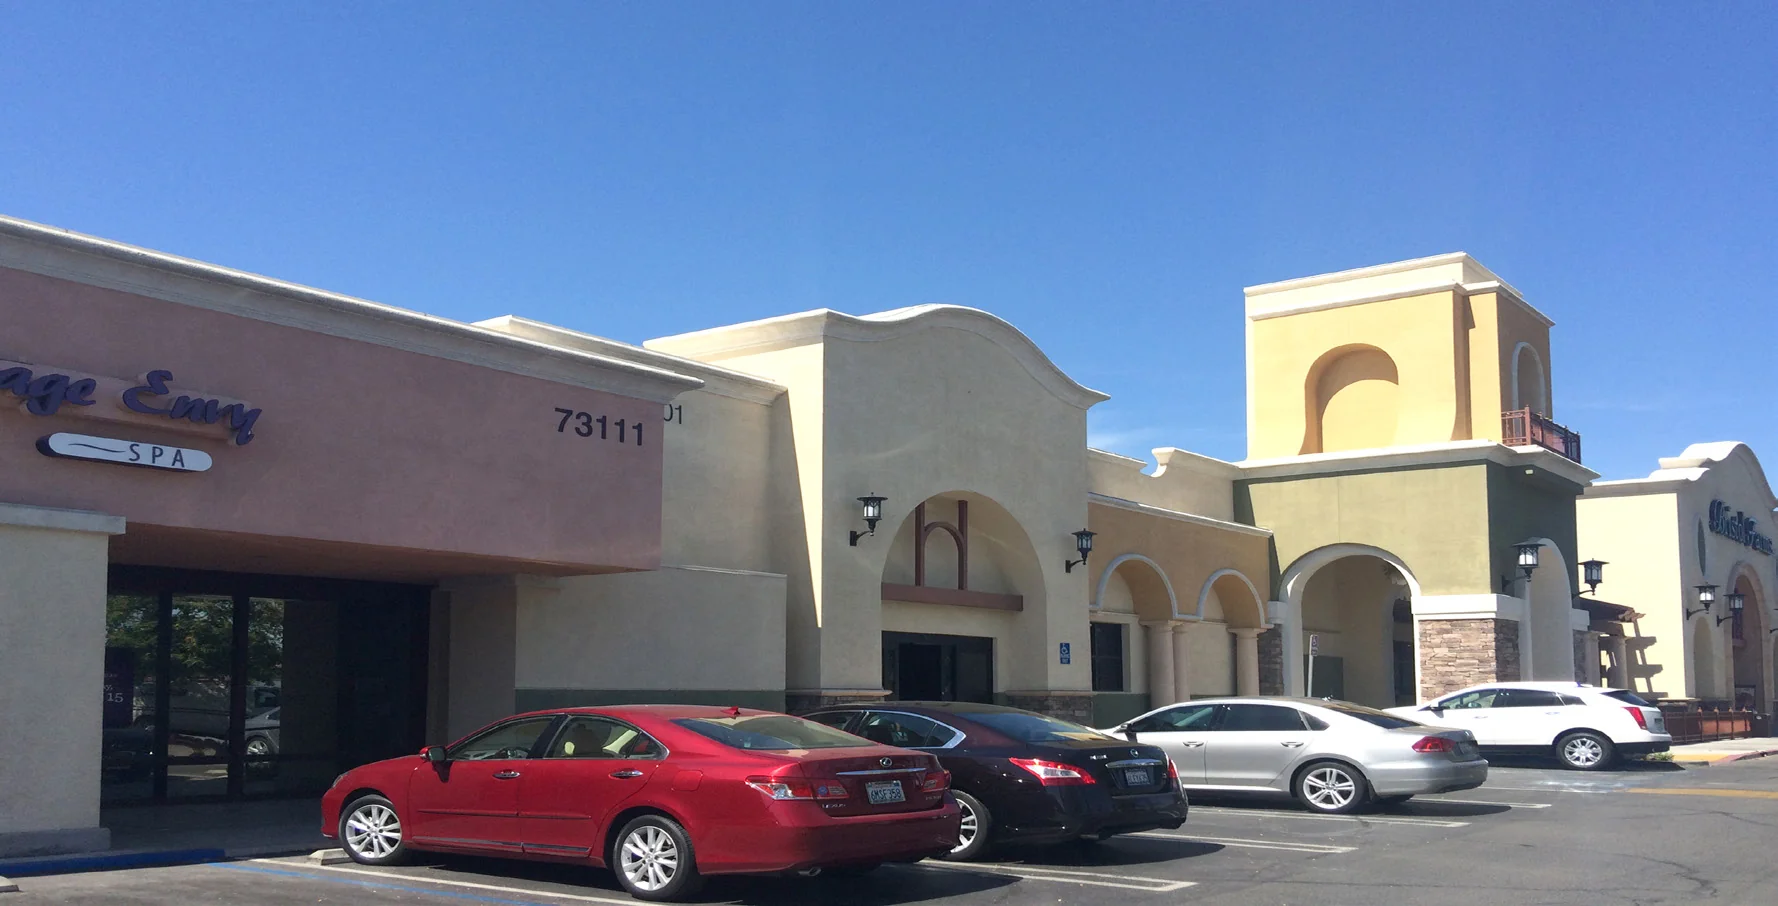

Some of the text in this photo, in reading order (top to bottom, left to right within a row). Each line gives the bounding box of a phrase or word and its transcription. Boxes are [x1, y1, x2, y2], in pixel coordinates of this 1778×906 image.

[122, 369, 262, 445] Envy
[555, 407, 643, 446] 73111
[128, 443, 185, 468] SPA
[107, 692, 124, 703] 15
